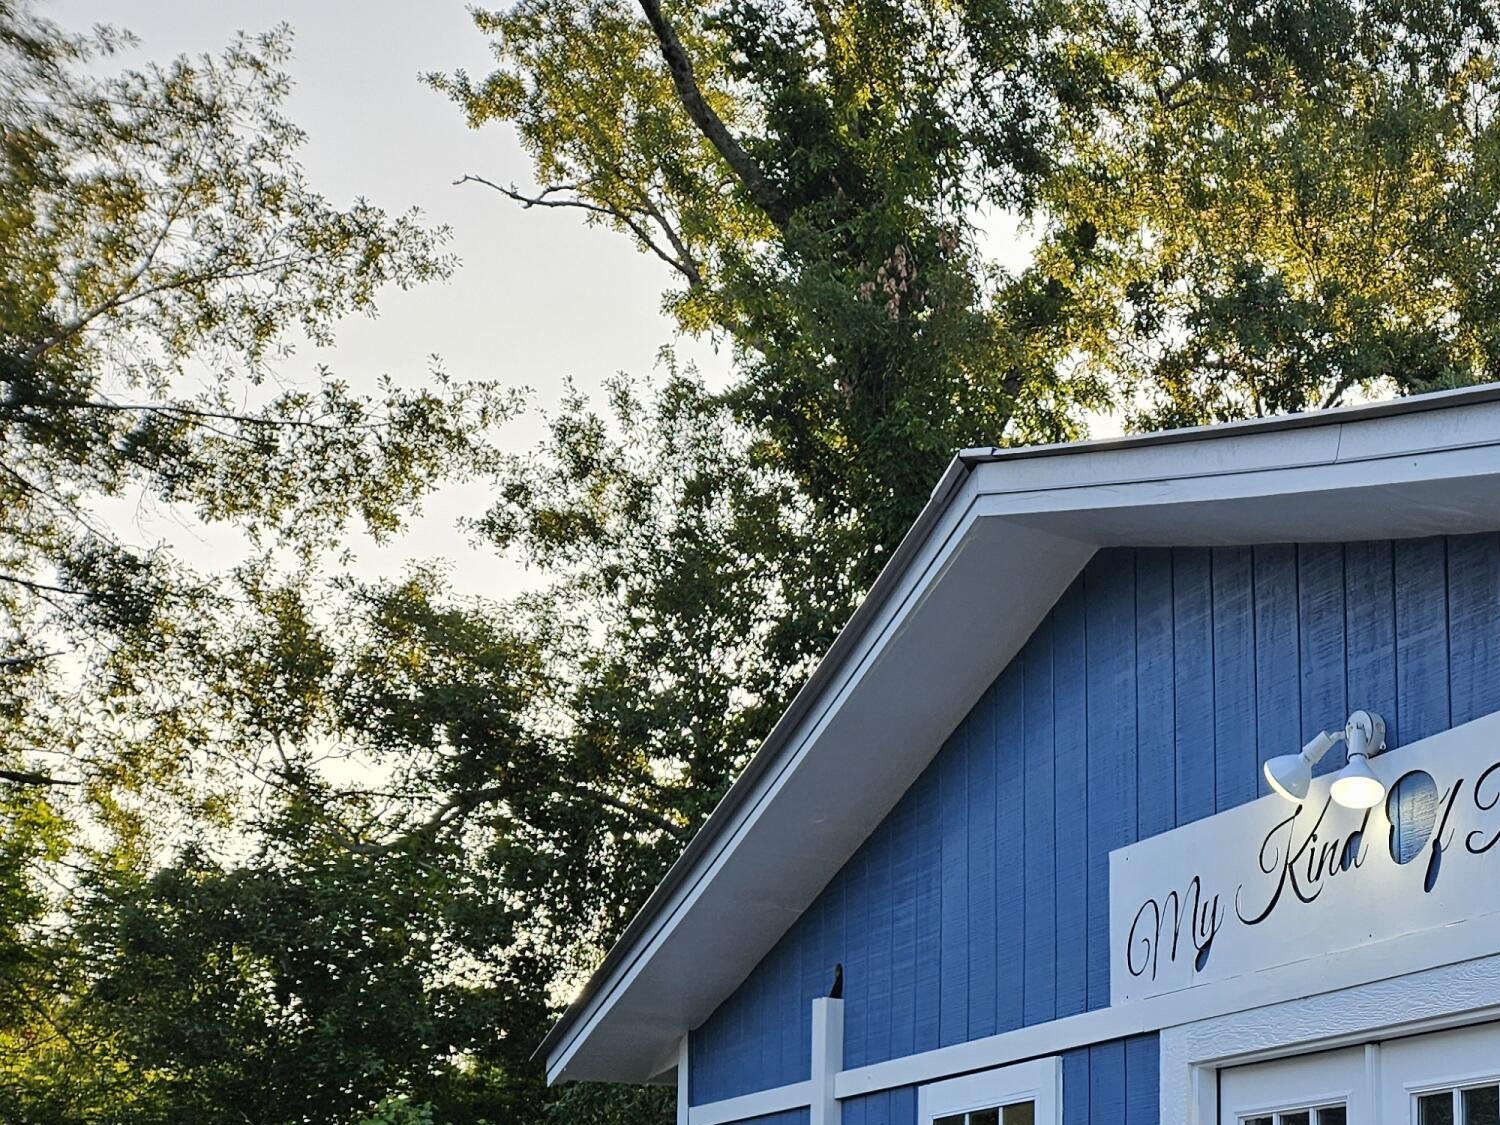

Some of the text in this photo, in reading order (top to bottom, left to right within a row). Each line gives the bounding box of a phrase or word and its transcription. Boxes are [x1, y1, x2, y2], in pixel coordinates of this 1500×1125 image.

[1127, 875, 1226, 981] My
[1235, 795, 1370, 926] Kind
[1385, 769, 1464, 893] Of
